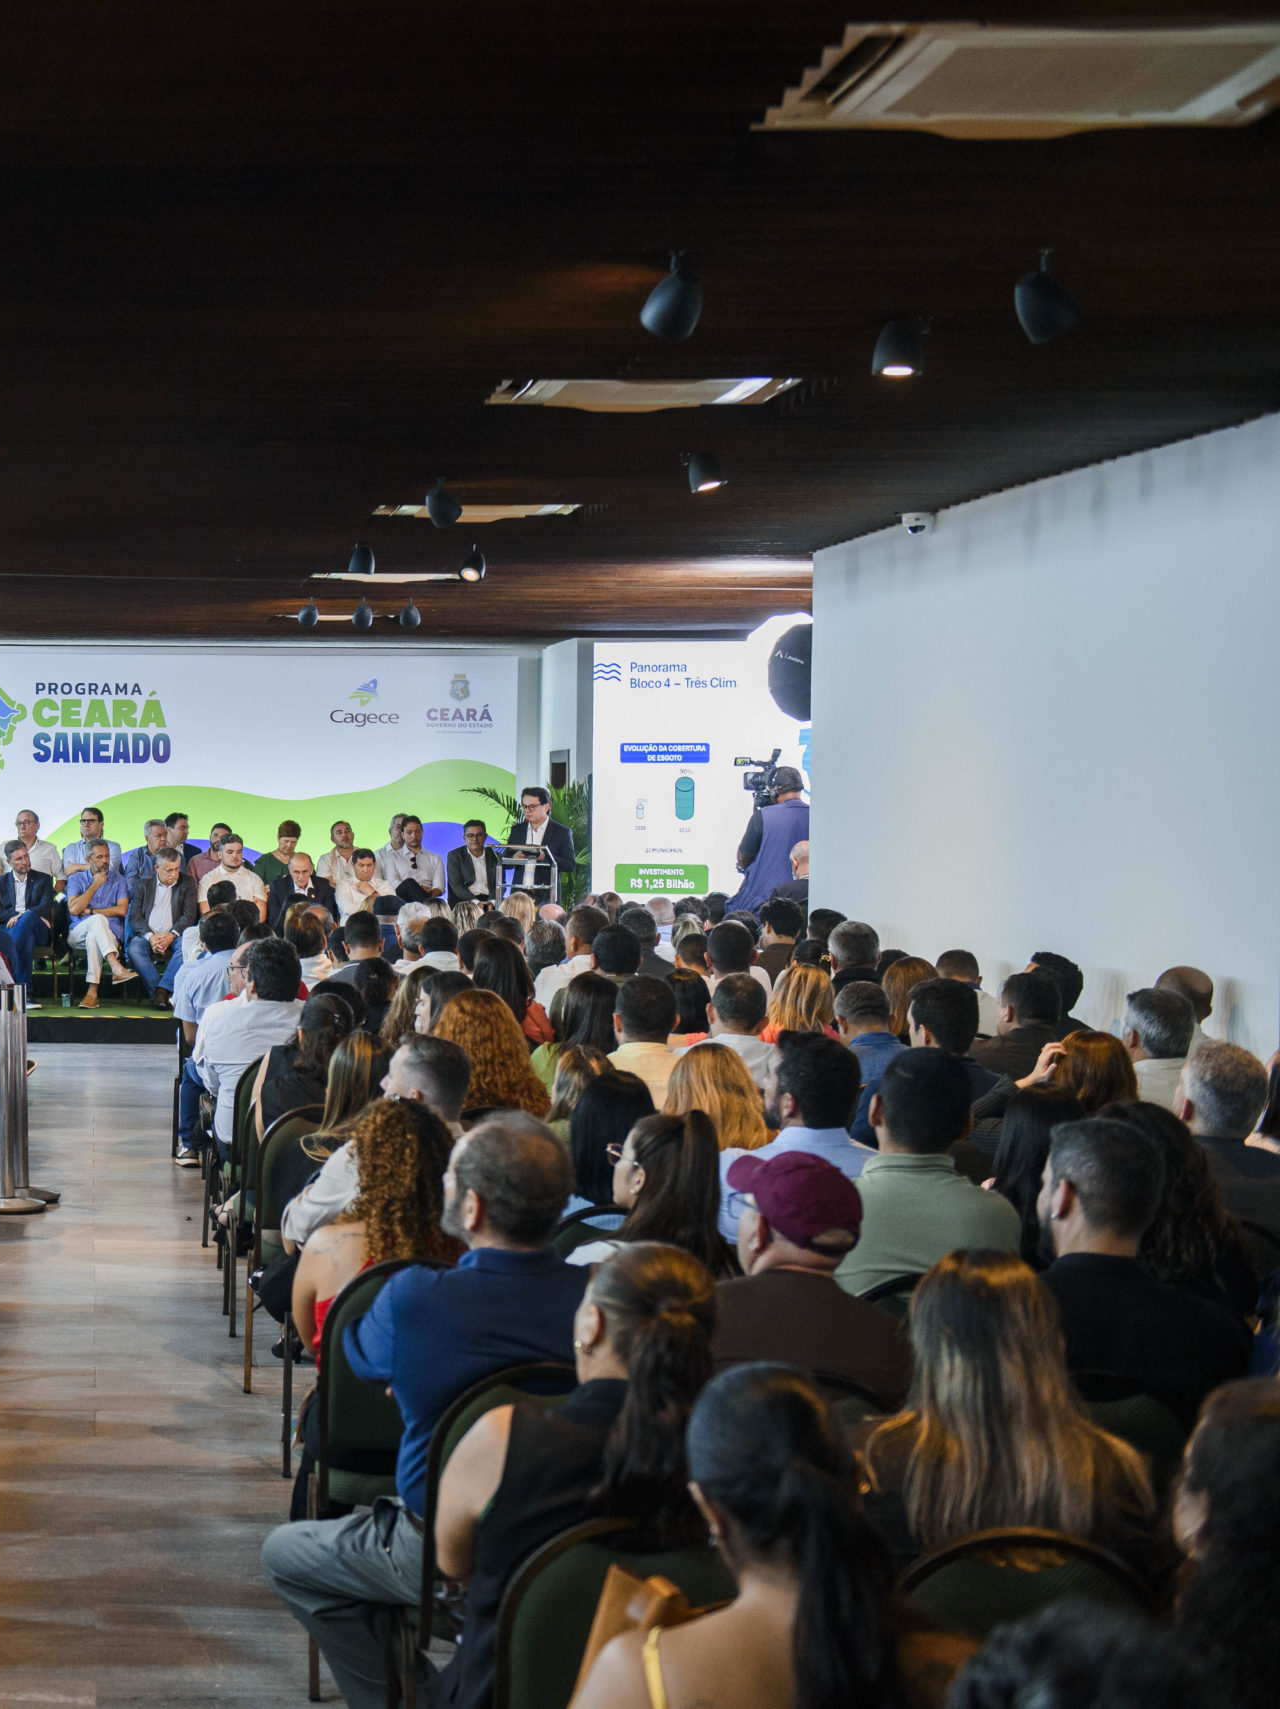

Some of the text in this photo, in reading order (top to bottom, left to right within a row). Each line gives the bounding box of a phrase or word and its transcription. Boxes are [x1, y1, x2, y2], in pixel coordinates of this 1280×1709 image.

[630, 662, 687, 673] Panorama
[35, 682, 143, 696] PROGRAMA
[630, 678, 662, 689] Bloco
[663, 678, 671, 688] 4
[685, 677, 708, 688] Três
[32, 690, 167, 728] CEARÁ
[426, 704, 493, 722] CEARÁ
[330, 709, 400, 728] Cagece
[32, 732, 171, 764] SANEADO
[624, 744, 657, 753] EVOLUÇÃO
[647, 754, 682, 762] DE ESGOTO
[638, 868, 685, 876] INVESTIMENTO
[630, 878, 695, 890] R$ 1,25 Bilhão
